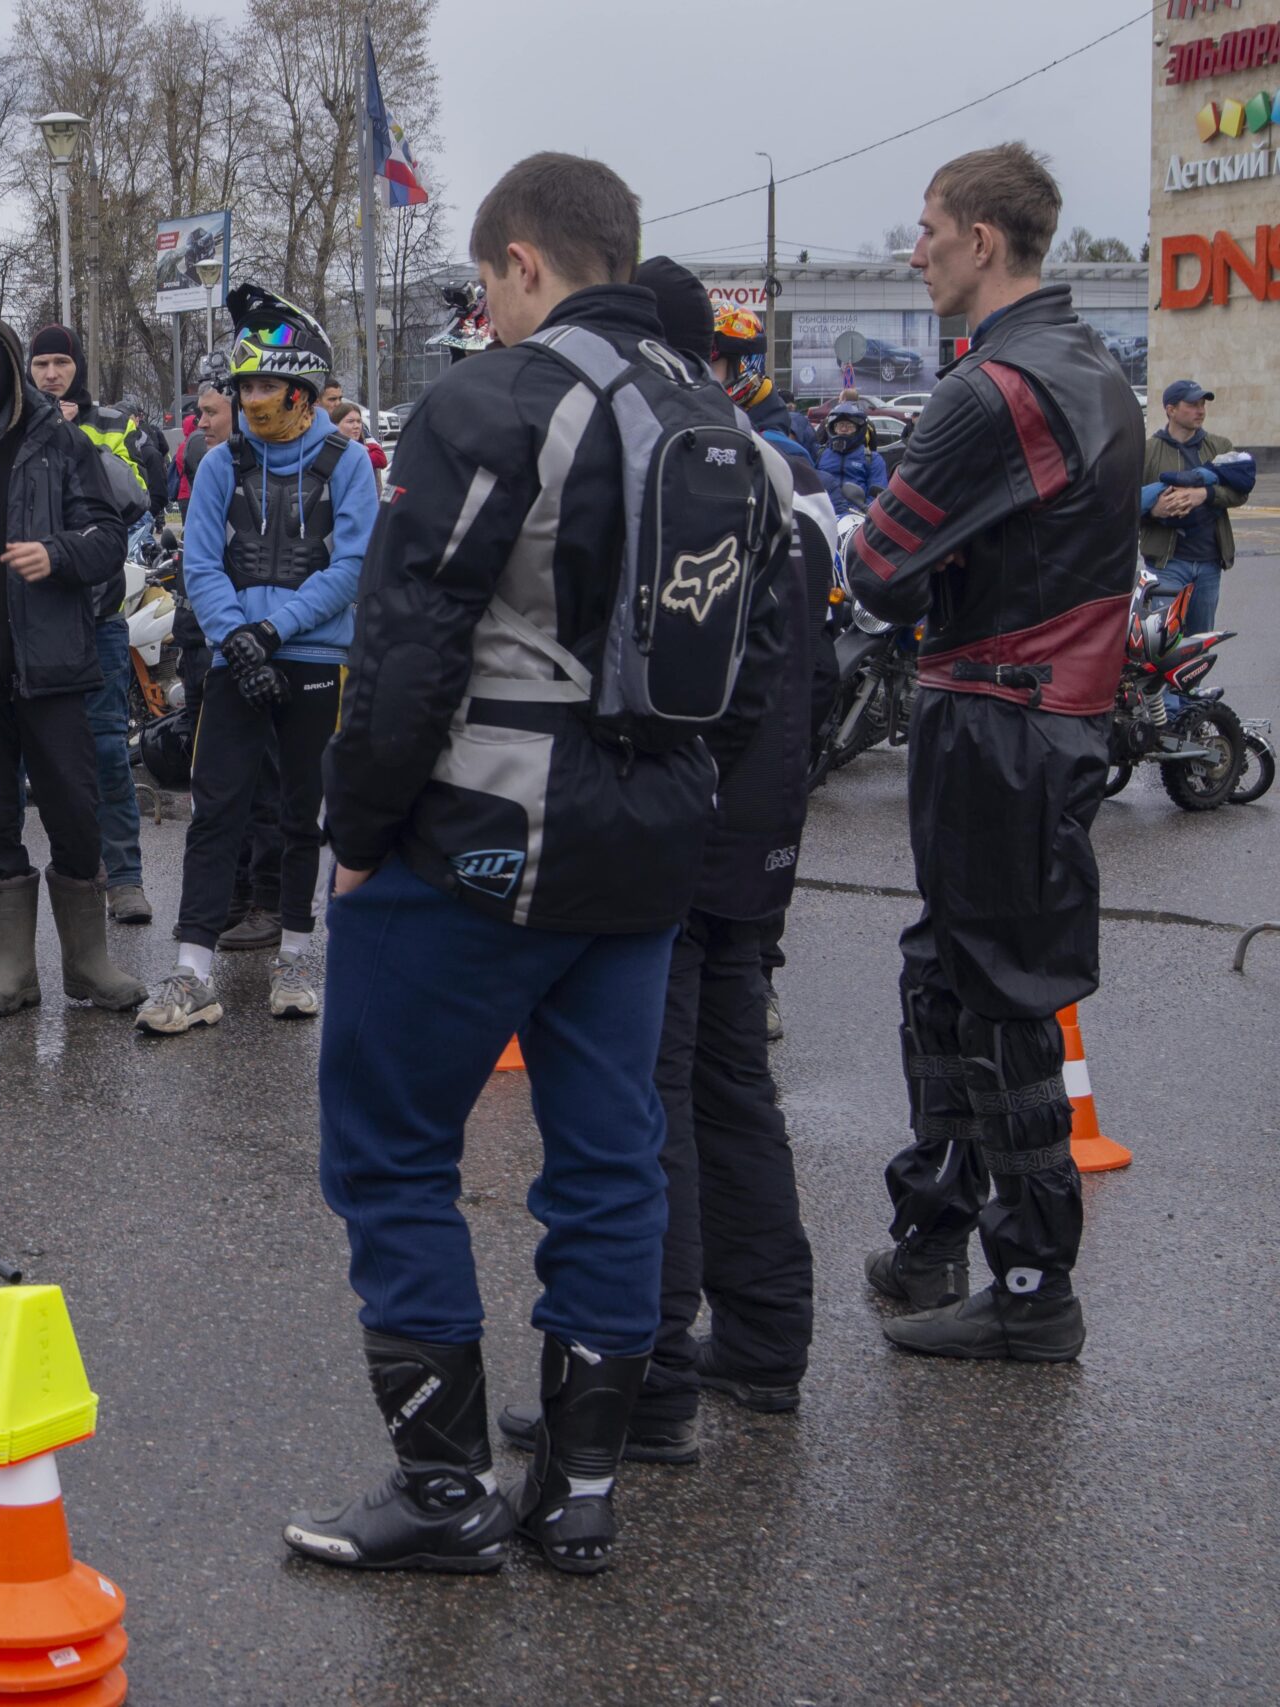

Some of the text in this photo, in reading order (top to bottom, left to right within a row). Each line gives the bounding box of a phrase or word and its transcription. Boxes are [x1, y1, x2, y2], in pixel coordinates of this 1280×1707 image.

[1164, 140, 1270, 192] Детский
[1161, 224, 1280, 310] DN
[706, 287, 768, 304] OYOTA
[798, 315, 858, 325] ОБНОВЛЕННАЯ
[798, 325, 829, 334] TOYOTA
